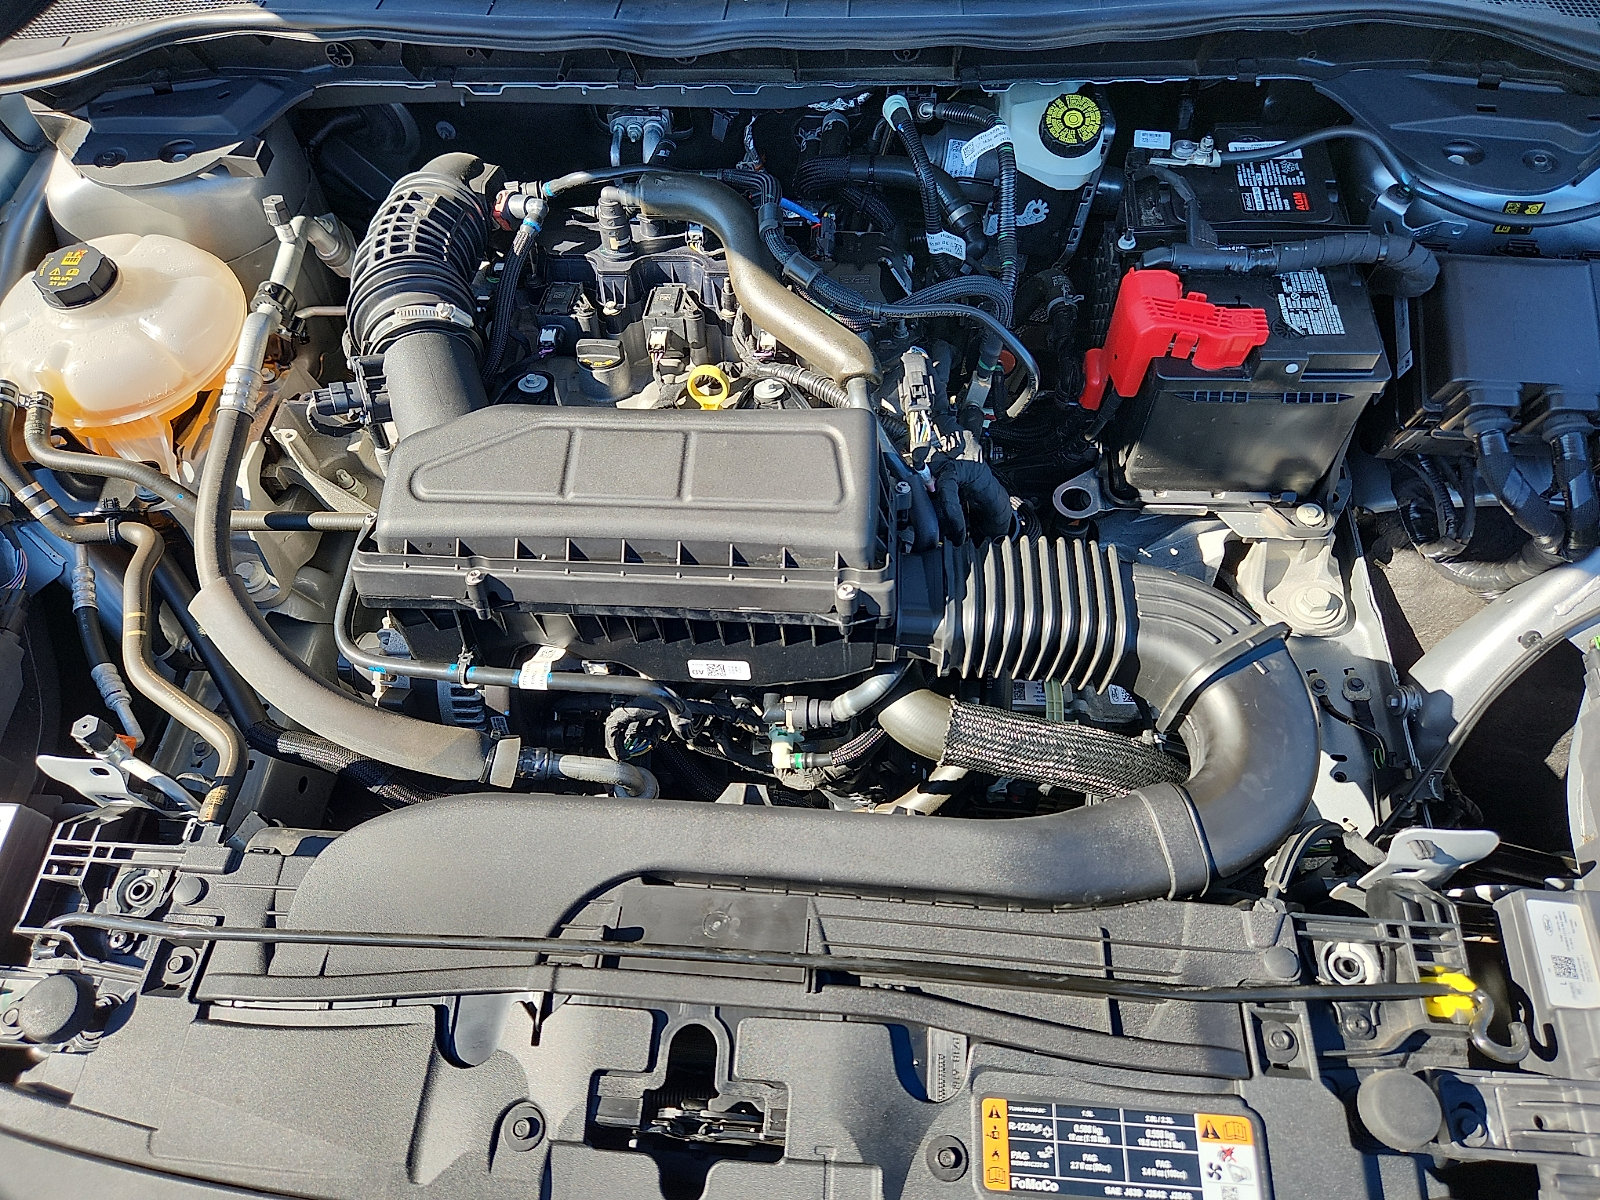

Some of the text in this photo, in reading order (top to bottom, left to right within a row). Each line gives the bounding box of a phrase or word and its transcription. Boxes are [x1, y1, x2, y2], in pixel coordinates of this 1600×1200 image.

[1293, 192, 1305, 211] AGM
[1011, 1151, 1030, 1160] PAG
[1082, 1154, 1098, 1162] PAG
[1011, 1177, 1059, 1192] FoMoCo
